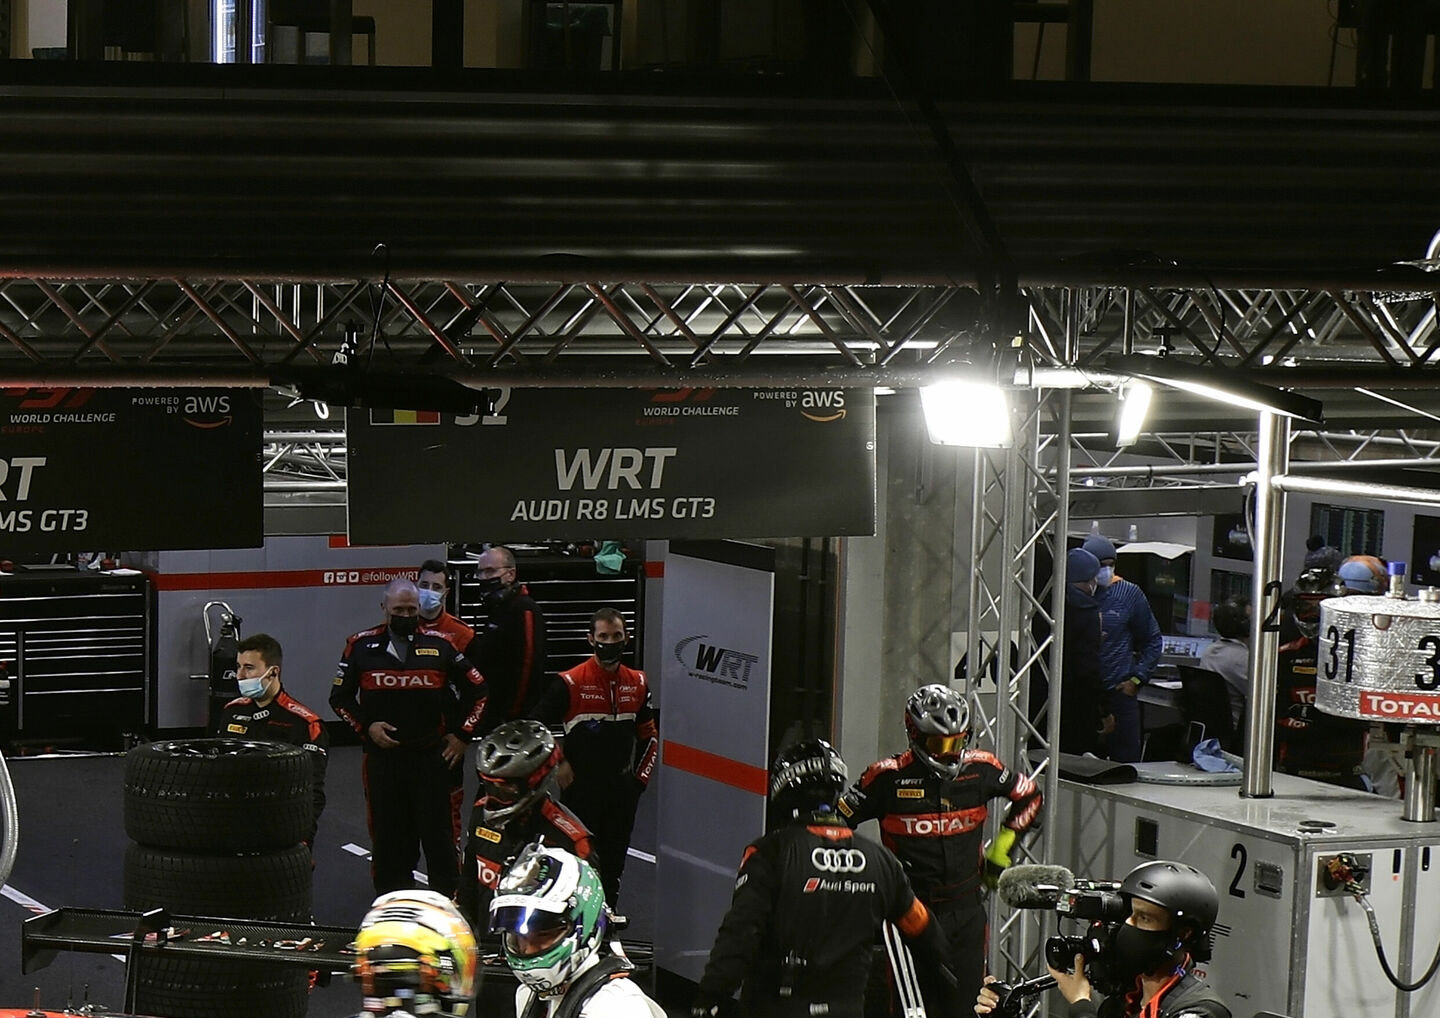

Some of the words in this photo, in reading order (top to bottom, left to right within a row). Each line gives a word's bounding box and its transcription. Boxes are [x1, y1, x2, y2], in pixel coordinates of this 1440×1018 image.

[132, 397, 180, 405] POWERED
[184, 396, 230, 413] aws
[753, 391, 797, 400] POWERED
[785, 400, 797, 408] BY
[802, 390, 845, 408] aws
[10, 414, 50, 424] WORLD
[53, 413, 116, 423] CHALLENGE
[643, 407, 680, 416] WORLD
[682, 406, 740, 416] CHALLENGE
[555, 447, 677, 490] WRT
[510, 500, 569, 522] AUDI
[576, 500, 608, 520] R8
[614, 499, 665, 519] LMS
[671, 498, 716, 518] GT3
[40, 510, 89, 531] GT3
[1262, 580, 1282, 632] 2
[696, 643, 759, 682] WRT
[1324, 625, 1356, 682] 31
[371, 673, 434, 687] TOTAL
[900, 816, 976, 835] TOTAL
[477, 859, 500, 888] TO
[1229, 843, 1248, 898] 2
[820, 879, 842, 890] Audi
[844, 880, 876, 893] Sport
